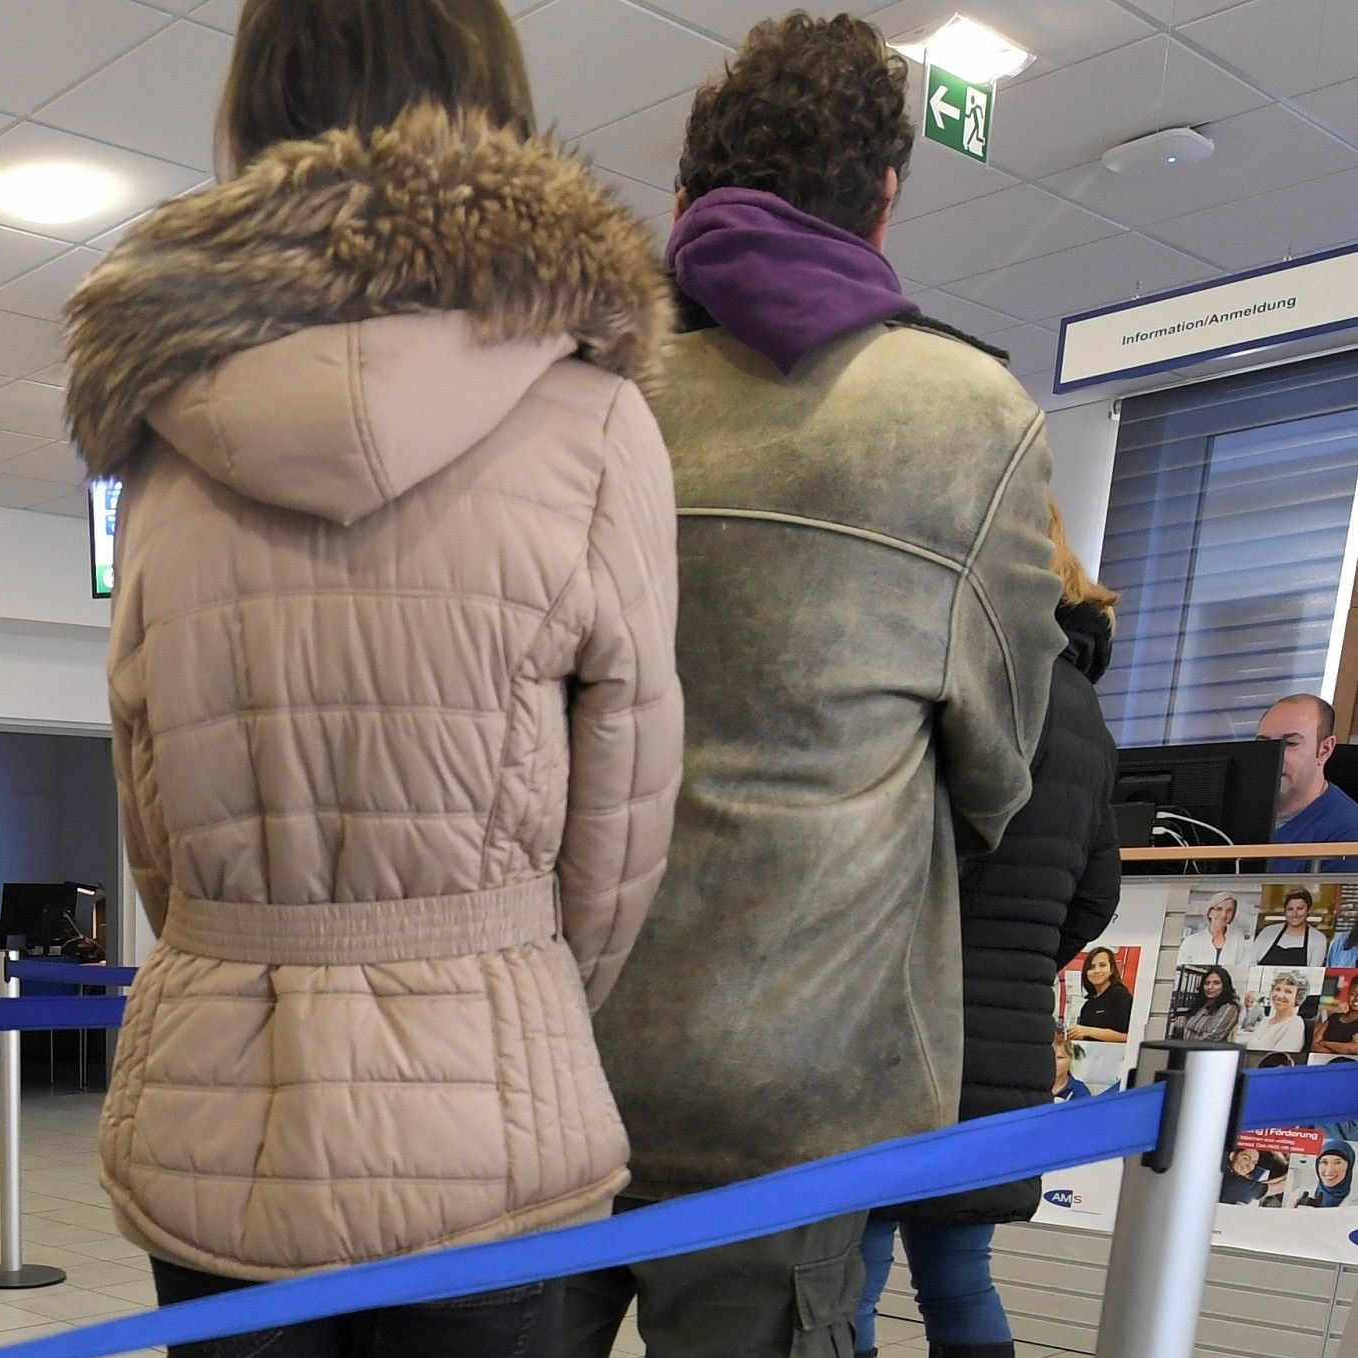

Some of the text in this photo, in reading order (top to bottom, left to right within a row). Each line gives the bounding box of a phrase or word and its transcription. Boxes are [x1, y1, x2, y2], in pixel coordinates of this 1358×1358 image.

[1121, 297, 1297, 346] Information/Anmeldung
[1270, 1128, 1318, 1140] Förderung
[1051, 1193, 1082, 1204] AMS
